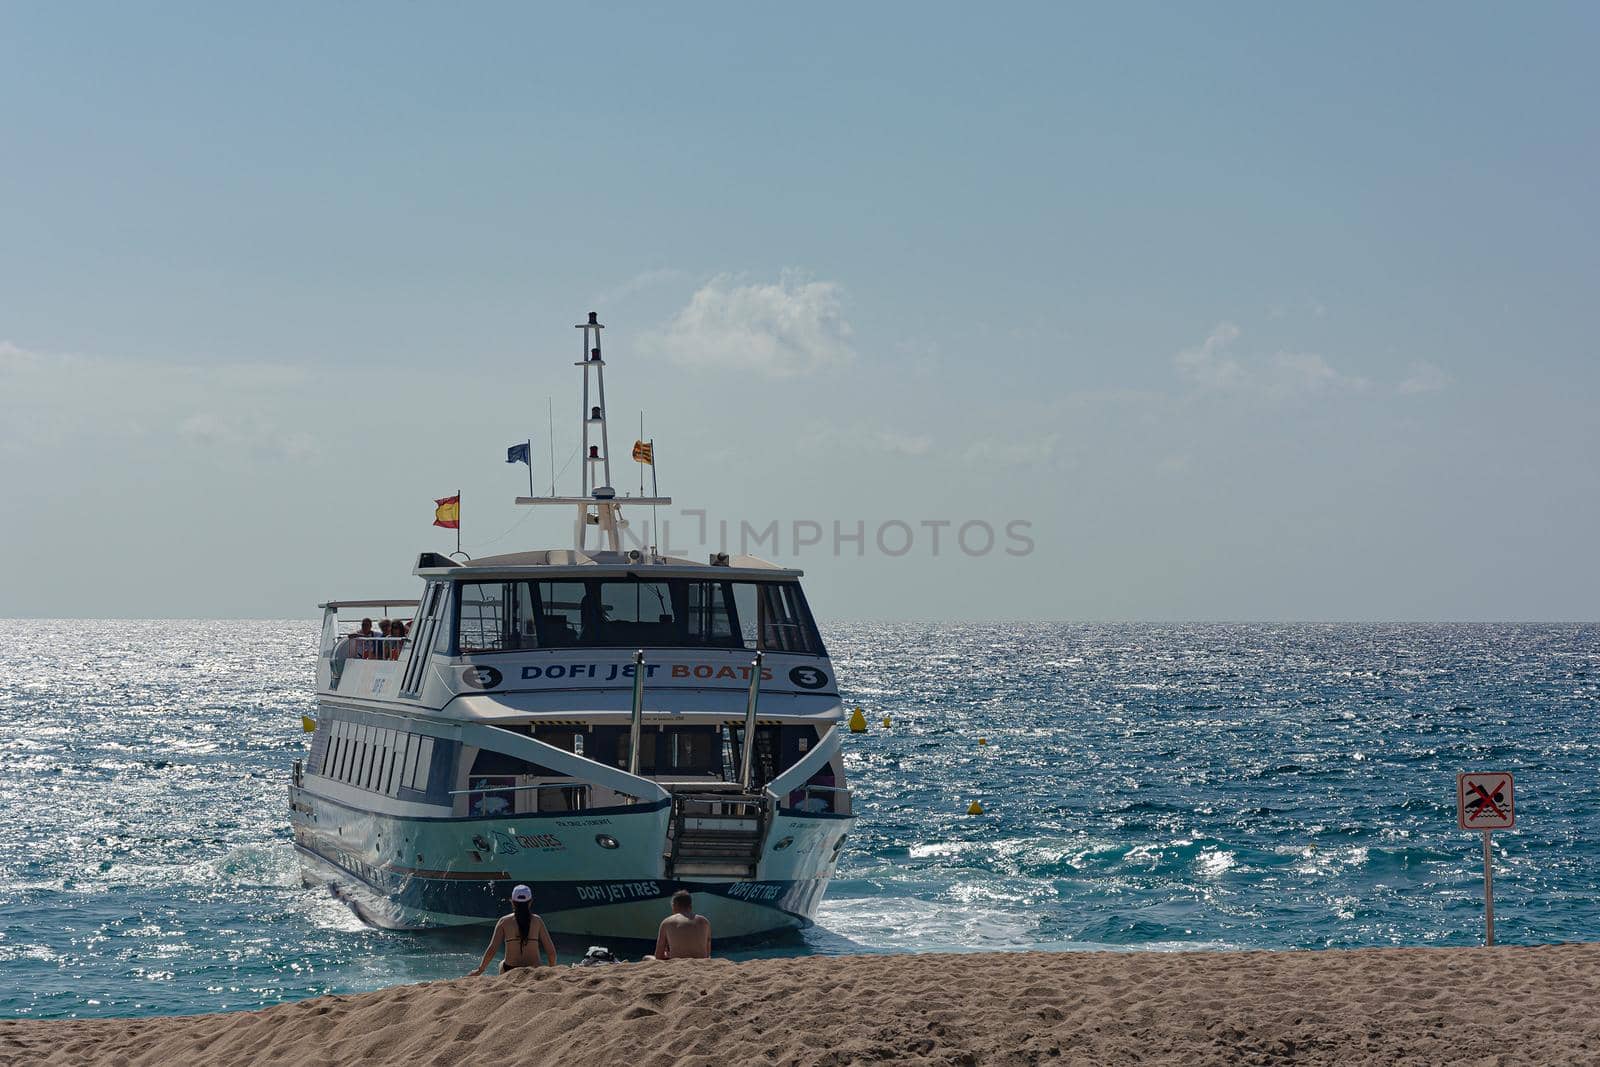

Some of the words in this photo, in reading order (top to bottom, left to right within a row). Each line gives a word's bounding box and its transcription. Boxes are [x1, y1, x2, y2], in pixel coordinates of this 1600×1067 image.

[521, 664, 596, 680] DOFI
[605, 664, 661, 681] JET
[671, 664, 774, 681] BOATS
[514, 833, 562, 848] CRUISES
[576, 886, 606, 900] DOFI
[605, 884, 626, 902] JET
[625, 881, 661, 897] TRES
